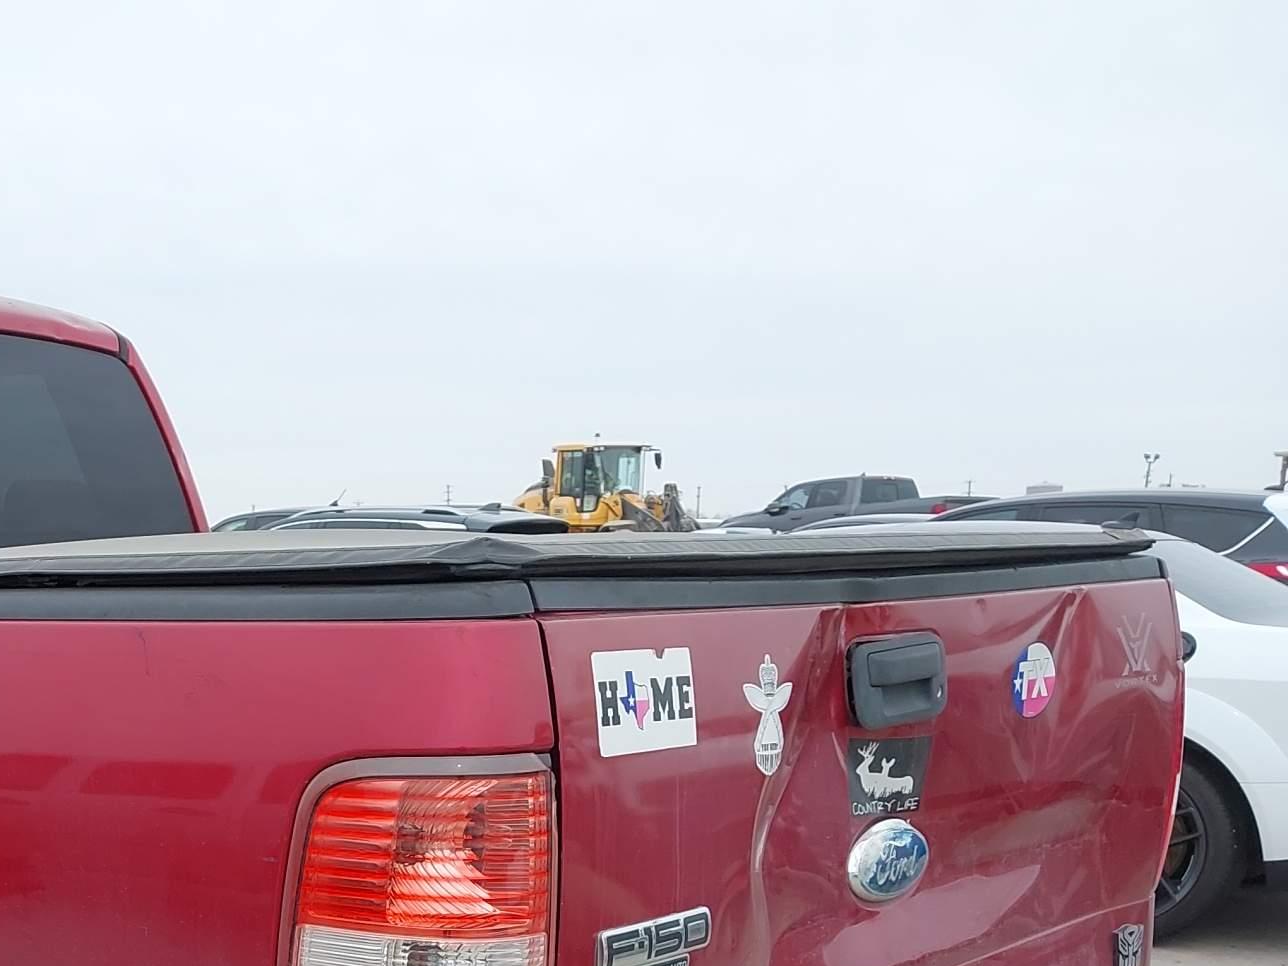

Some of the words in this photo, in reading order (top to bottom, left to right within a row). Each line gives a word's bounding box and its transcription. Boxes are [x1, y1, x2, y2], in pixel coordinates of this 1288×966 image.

[597, 675, 693, 728] HME
[1018, 657, 1050, 701] TX
[852, 799, 896, 816] COUNTRY
[897, 797, 920, 811] LIFE
[876, 838, 918, 886] Ford
